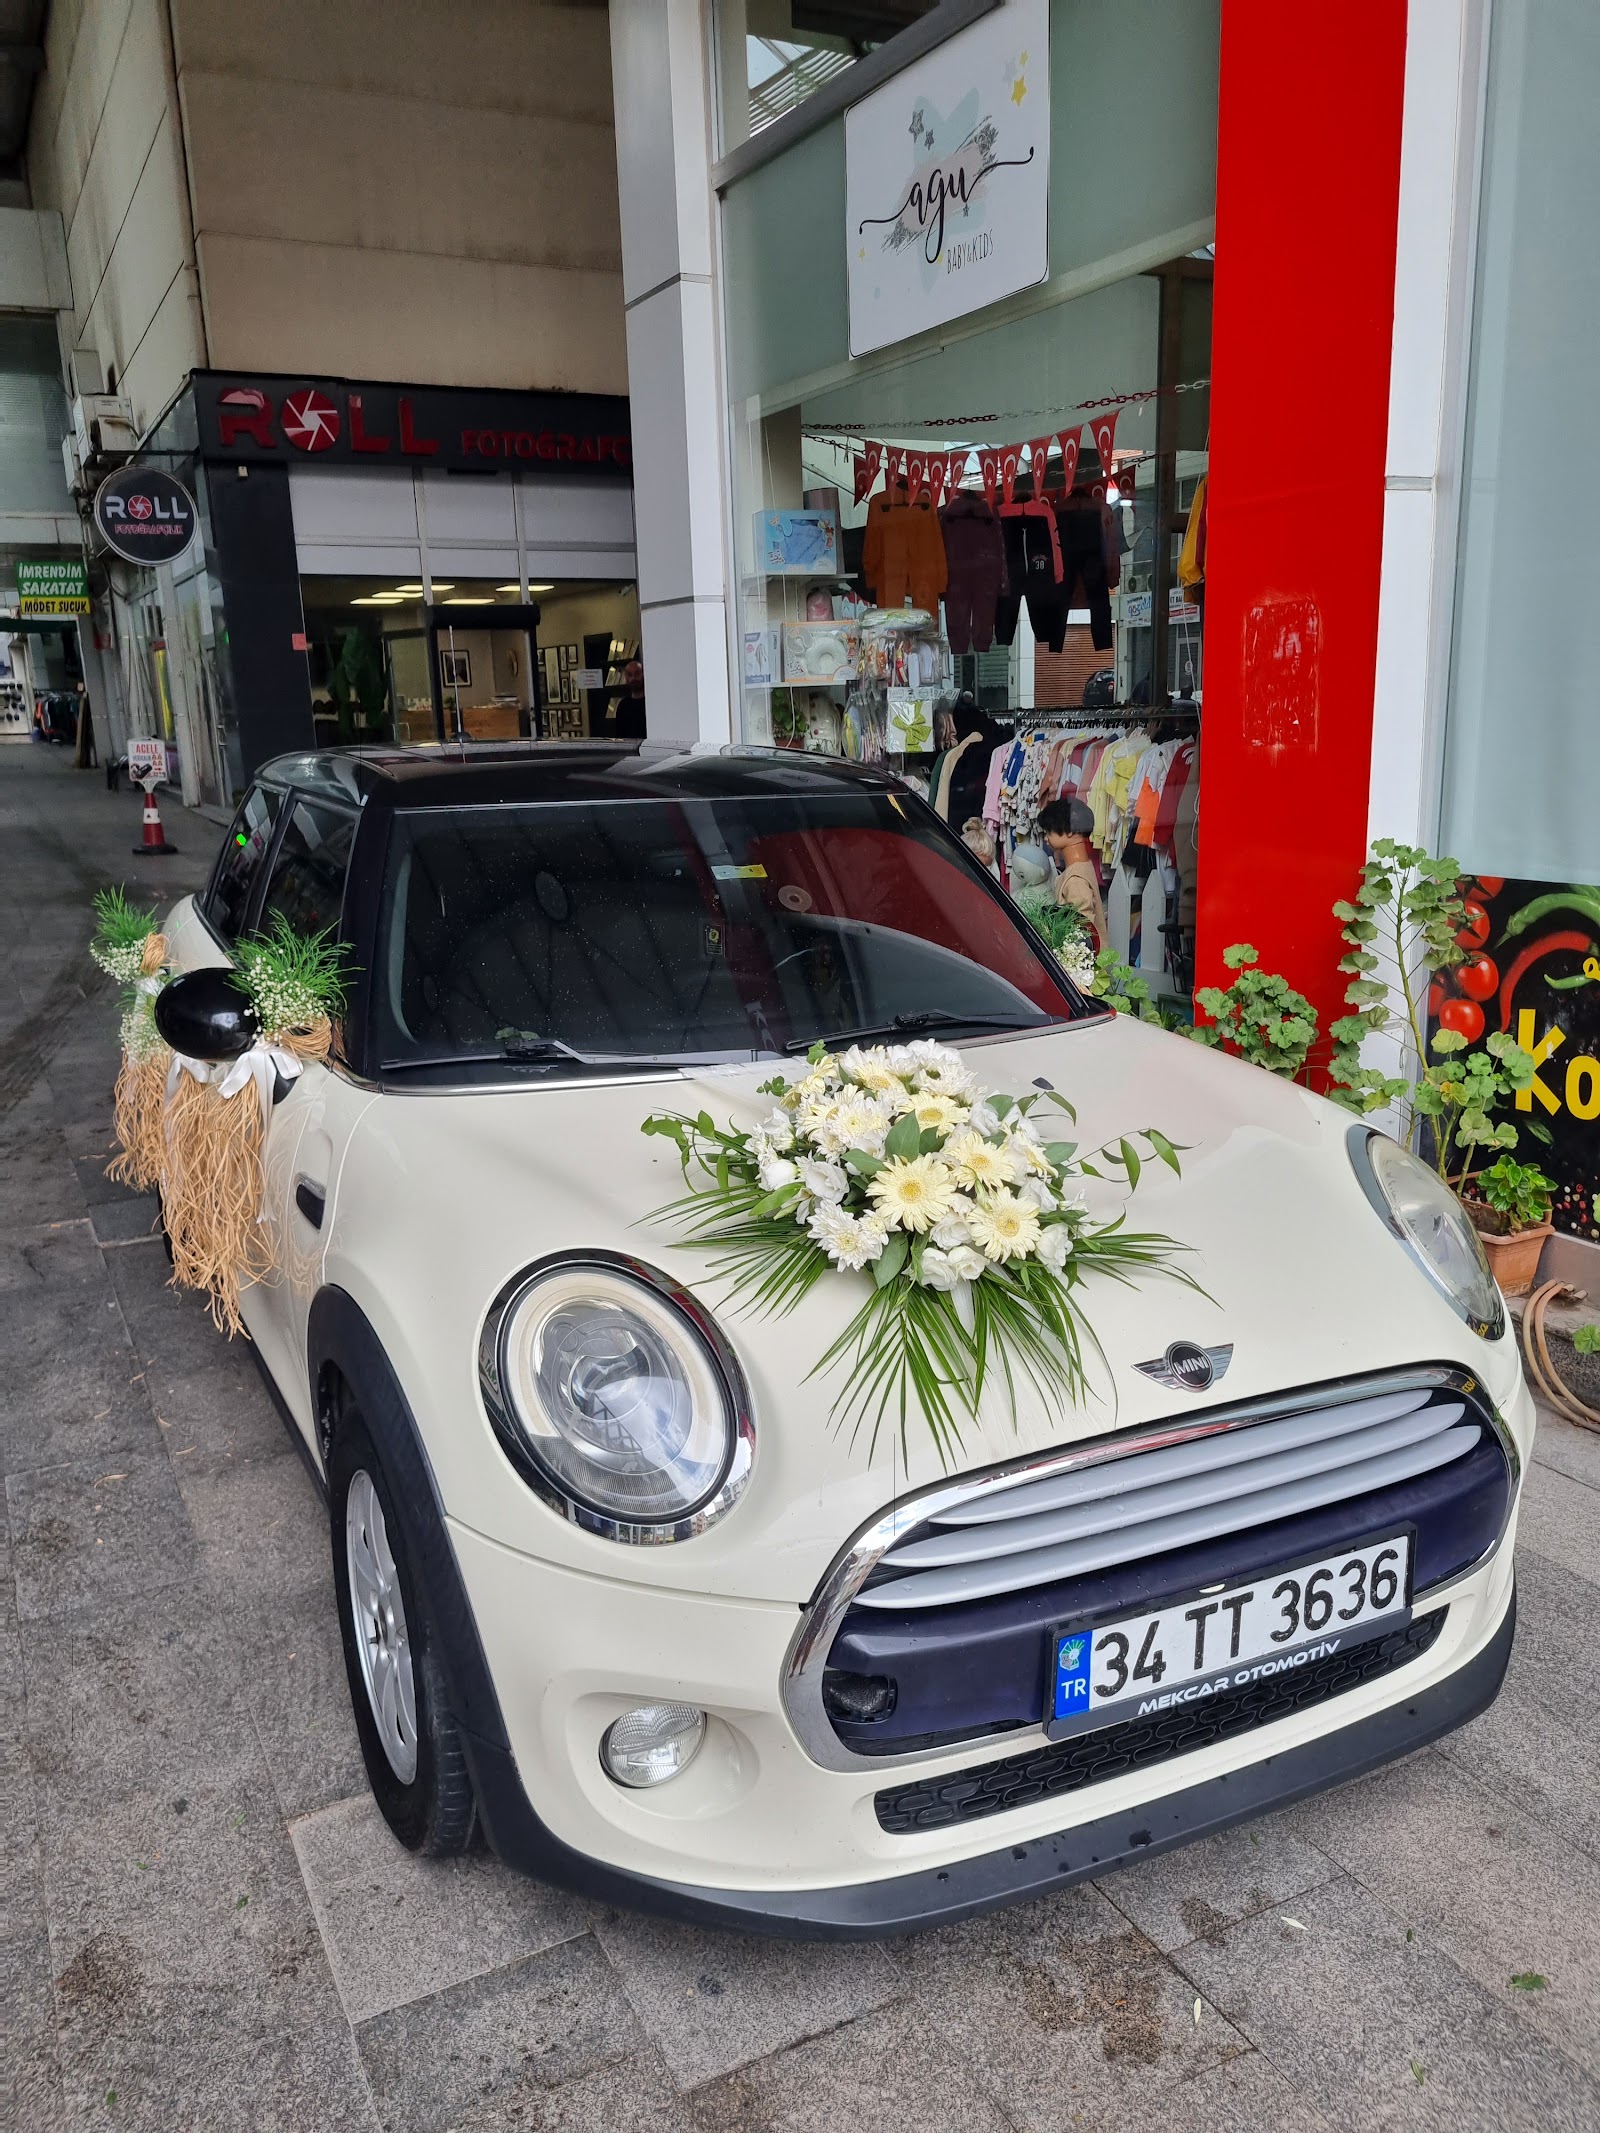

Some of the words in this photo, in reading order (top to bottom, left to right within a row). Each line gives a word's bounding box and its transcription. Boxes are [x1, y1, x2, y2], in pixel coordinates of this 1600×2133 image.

[947, 229, 994, 274] BABY&KIDS
[217, 387, 440, 456] ROLL
[105, 495, 189, 520] ROLL
[18, 562, 82, 579] İMRENDİM
[21, 581, 84, 596] SAKATAT
[24, 598, 56, 612] MÖDET
[1173, 1356, 1209, 1375] MINI
[1060, 1678, 1087, 1700] TR
[1093, 1620, 1167, 1698] 34
[1185, 1590, 1254, 1670] TT
[1269, 1548, 1399, 1643] 3636
[1137, 1678, 1231, 1715] MEKCAR
[1234, 1639, 1341, 1684] OTOMOTİV
